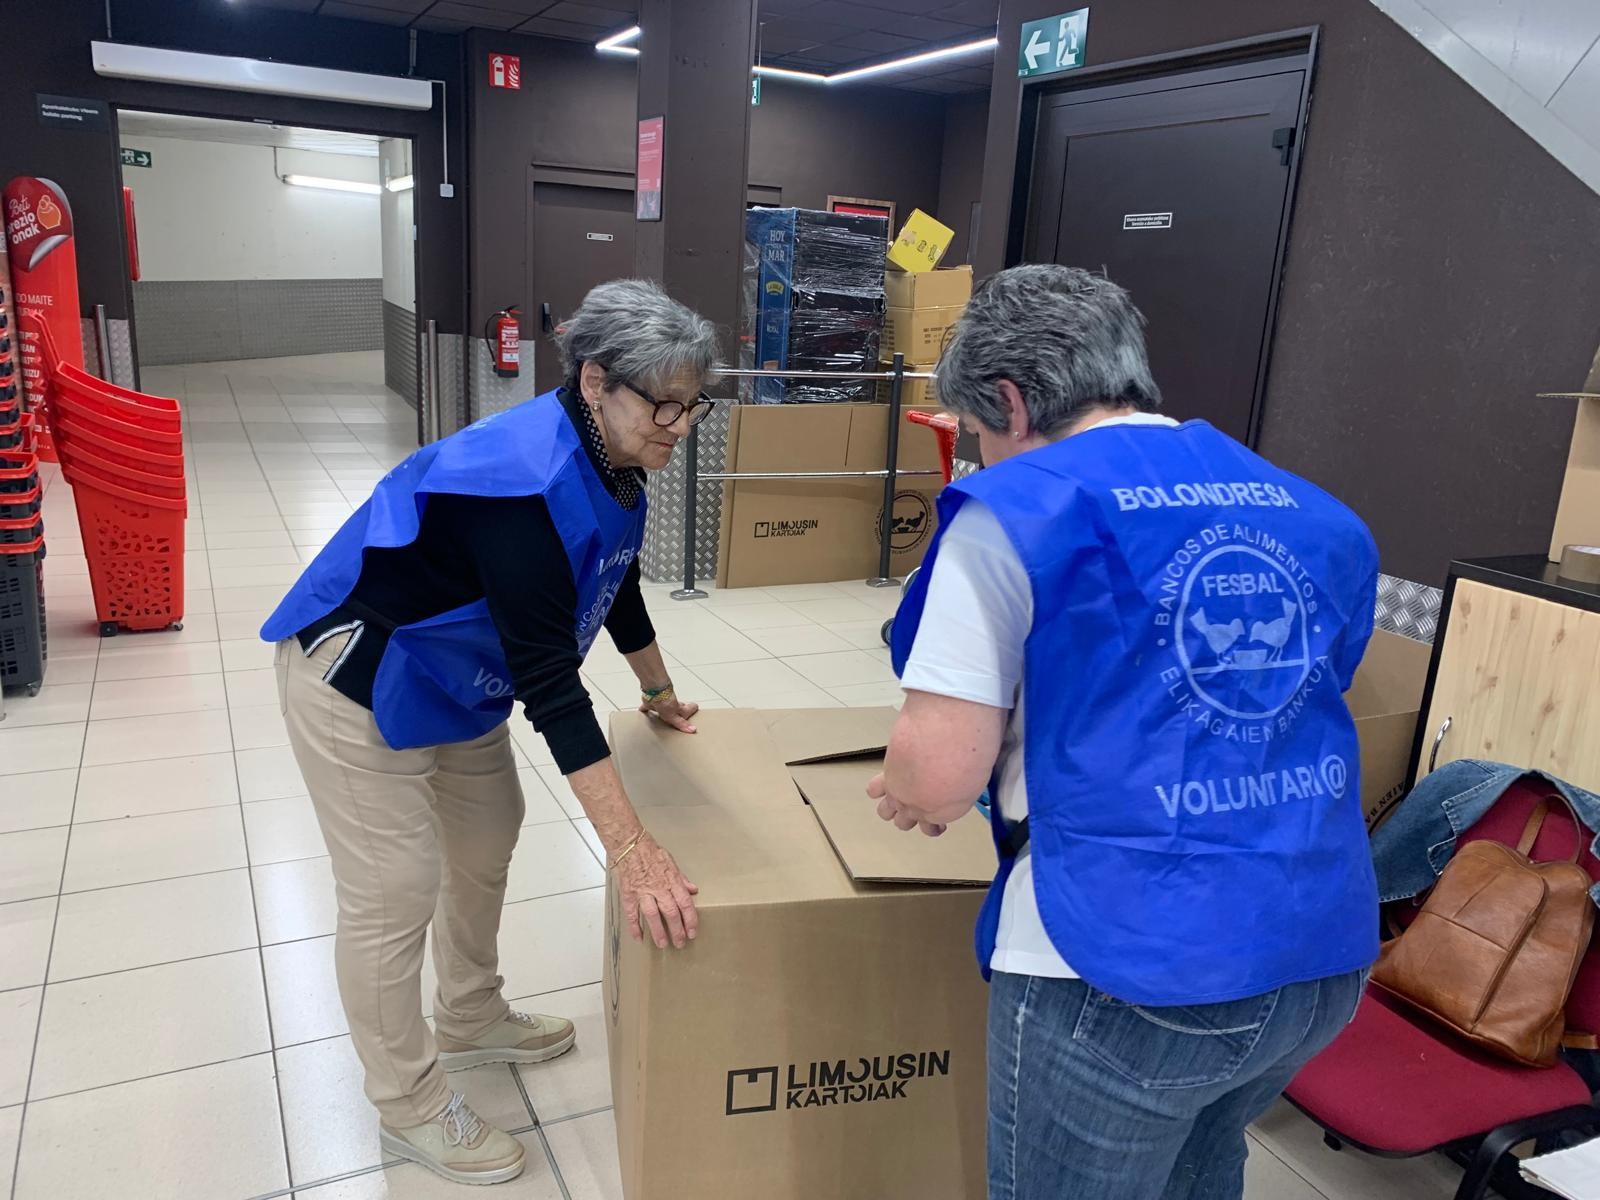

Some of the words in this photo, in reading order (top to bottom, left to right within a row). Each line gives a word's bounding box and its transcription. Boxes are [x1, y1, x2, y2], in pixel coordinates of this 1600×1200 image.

[12, 223, 41, 245] onak
[770, 229, 786, 242] HOY
[768, 249, 785, 262] MAR
[27, 293, 54, 306] MAITE
[1111, 482, 1299, 511] BOLONDRESA
[771, 519, 818, 530] LIMOUSIN
[1155, 538, 1202, 627] BANCOS
[1200, 523, 1230, 545] DE
[1233, 523, 1318, 615] ALIMENTOS
[1202, 572, 1285, 598] FESBAL
[1160, 666, 1275, 743] ELIKAGAIEN
[1278, 655, 1328, 734] BANKUA
[1154, 754, 1347, 818] VOLUNTARI@
[787, 1050, 950, 1090] LIMOUSIN
[786, 1080, 909, 1109] KARTOIAK
